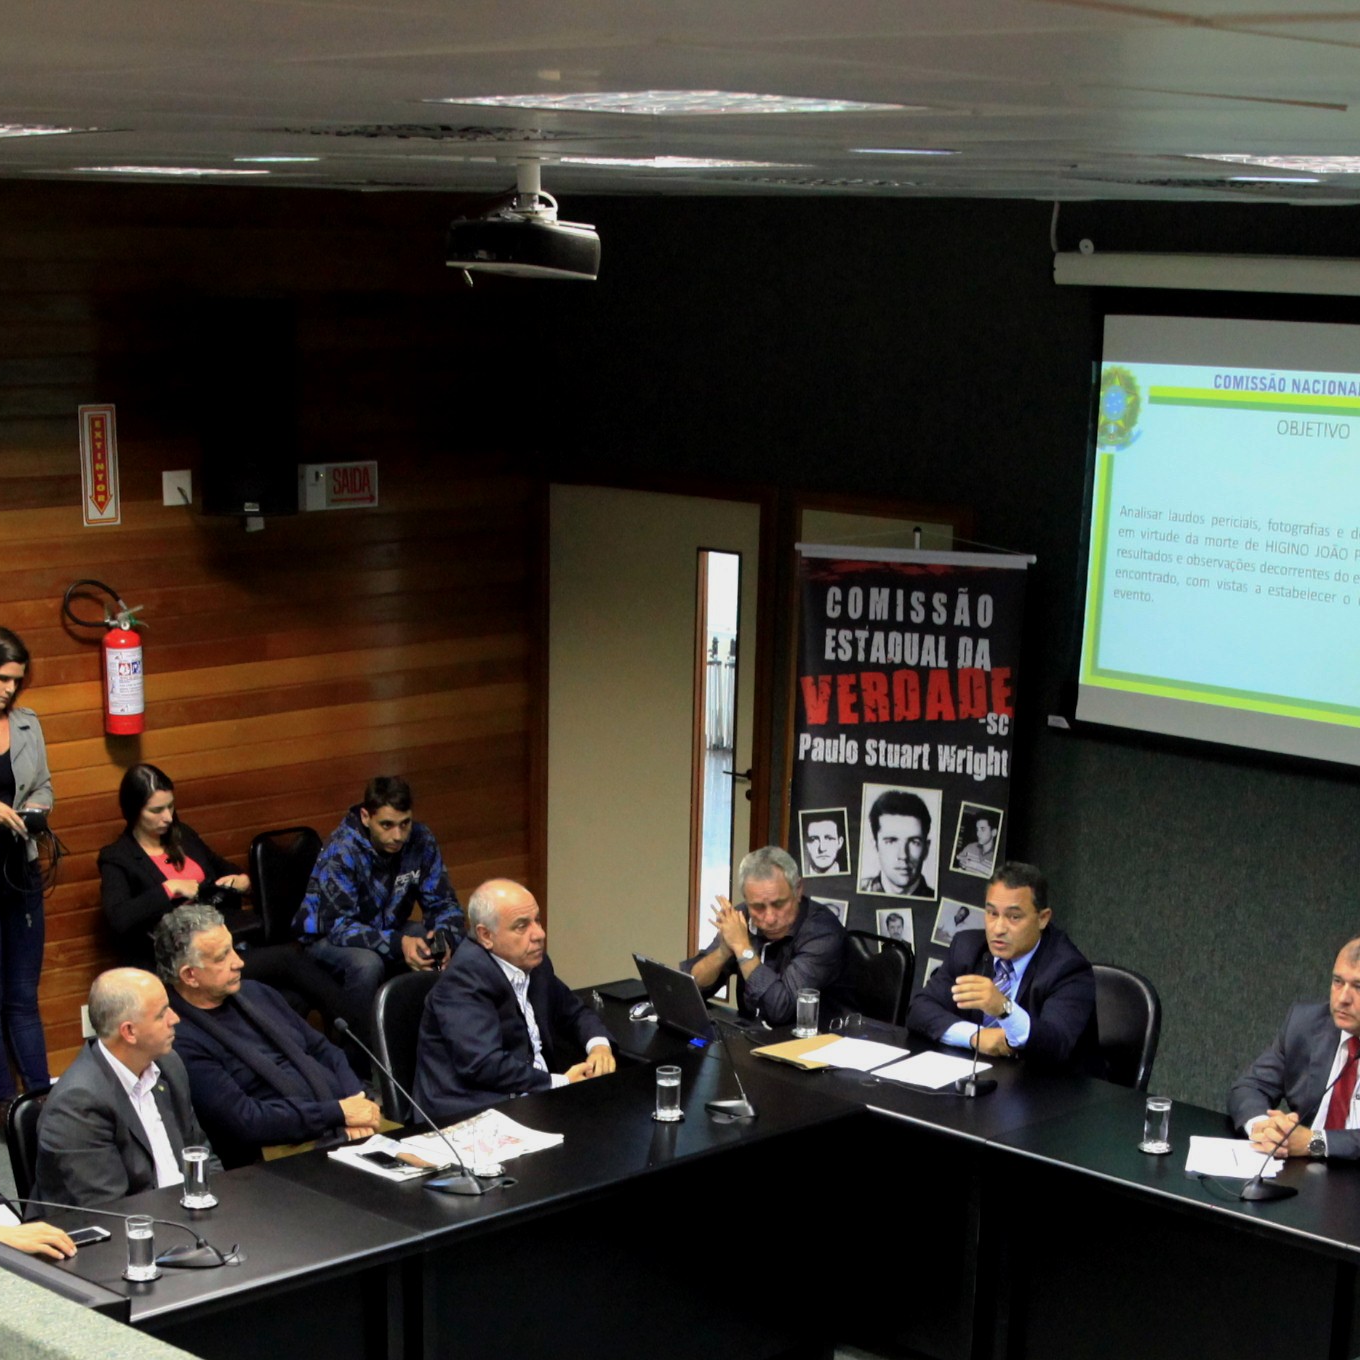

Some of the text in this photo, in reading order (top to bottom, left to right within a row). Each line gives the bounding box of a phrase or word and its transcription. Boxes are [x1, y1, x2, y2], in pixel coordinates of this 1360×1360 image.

[1213, 373, 1286, 392] COMISSÃO
[1276, 419, 1350, 440] OBJETIVO
[94, 420, 106, 502] EXTINTOR
[1120, 505, 1162, 521] Analisar
[1168, 509, 1205, 525] laudos
[1211, 515, 1261, 531] periciais,
[1268, 518, 1330, 537] fotografias
[1337, 529, 1344, 538] e
[1118, 527, 1135, 538] em
[1140, 529, 1180, 543] virtude
[1185, 532, 1199, 545] da
[1205, 537, 1239, 549] morte
[1244, 538, 1259, 551] de
[1265, 540, 1309, 556] HIGINO
[1314, 543, 1348, 561] JOÃO
[1117, 547, 1173, 563] resultados
[1176, 554, 1183, 564] e
[1186, 554, 1256, 573] observações
[1260, 561, 1330, 581] decorrentes
[1334, 570, 1350, 583] do
[1113, 588, 1154, 602] evento.
[1115, 567, 1180, 586] encontrado,
[1185, 577, 1210, 588] com
[1216, 579, 1248, 593] vistas
[1255, 585, 1262, 594] a
[1268, 583, 1336, 603] estabelecer
[1343, 595, 1351, 605] o
[826, 587, 994, 629] COMISSÃO
[824, 628, 991, 672] ESTADUAL DA
[801, 666, 1014, 726] VERDADE
[798, 732, 1009, 781] Paulo Stuart Wright
